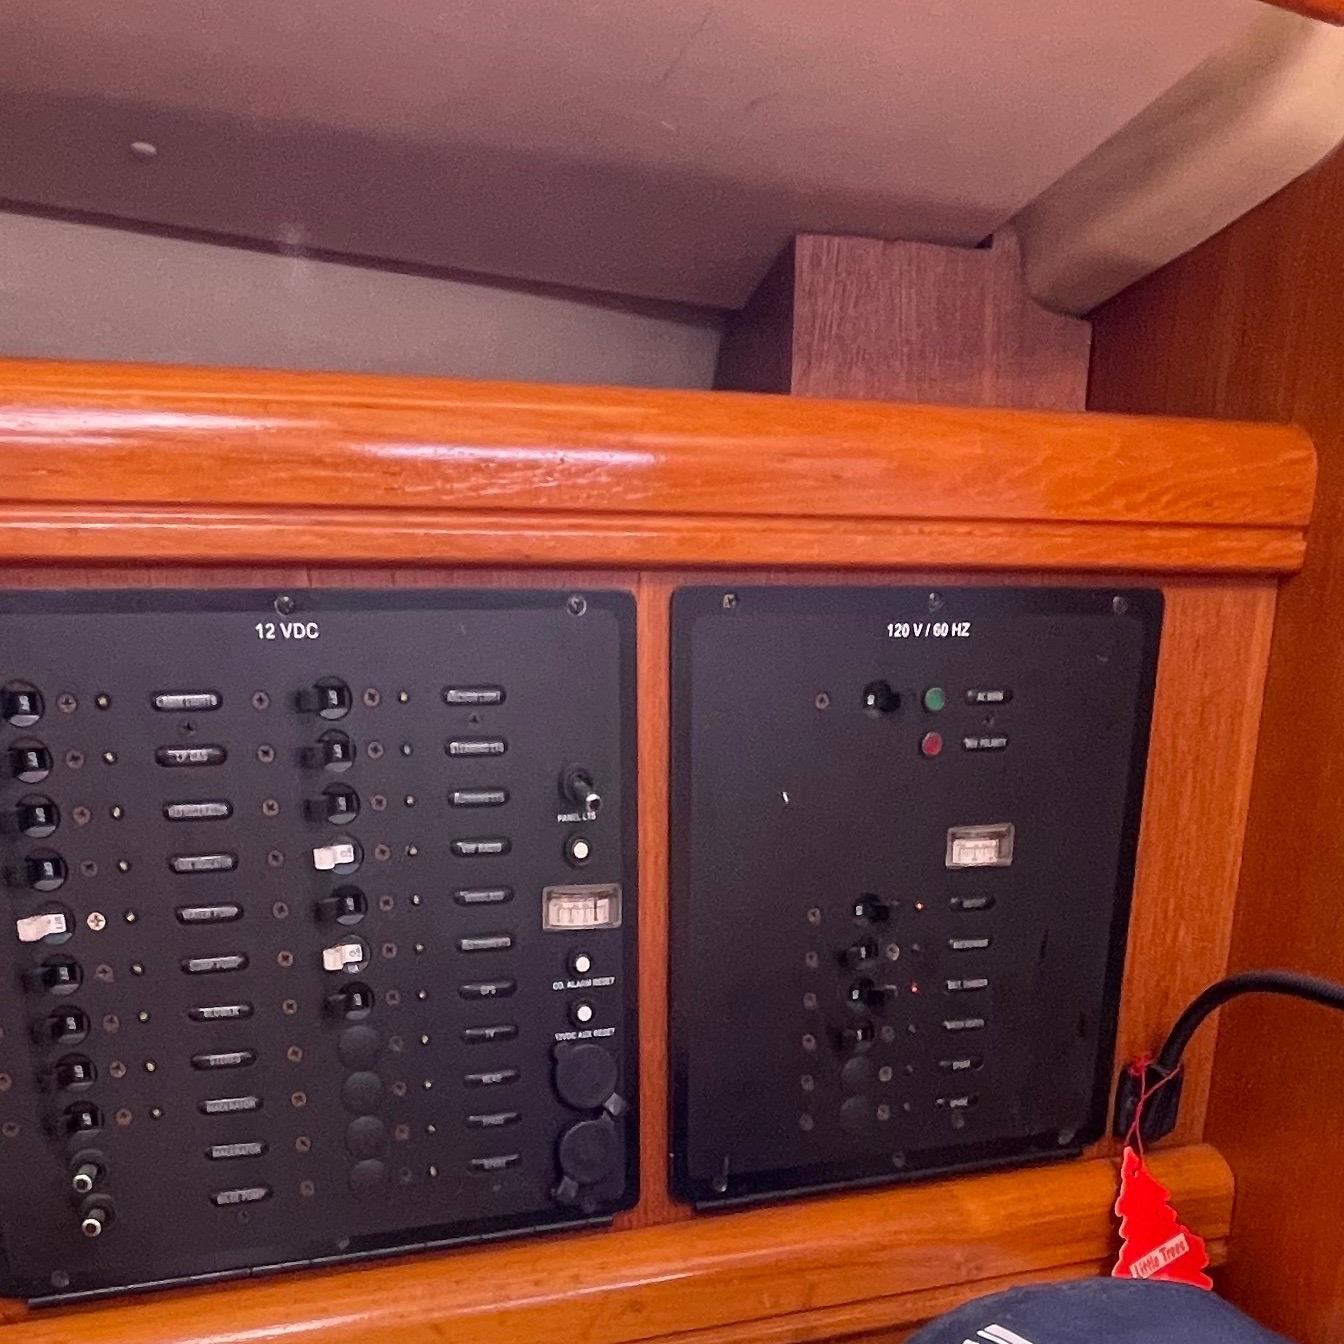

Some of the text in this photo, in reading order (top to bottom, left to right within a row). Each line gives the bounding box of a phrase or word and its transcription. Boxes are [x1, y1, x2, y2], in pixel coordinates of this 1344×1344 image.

[256, 622, 320, 639] 12 VDC
[887, 623, 910, 637] 120
[913, 623, 923, 637] V
[933, 623, 949, 637] 60
[951, 622, 971, 637] HZ
[1159, 1240, 1186, 1262] Trees
